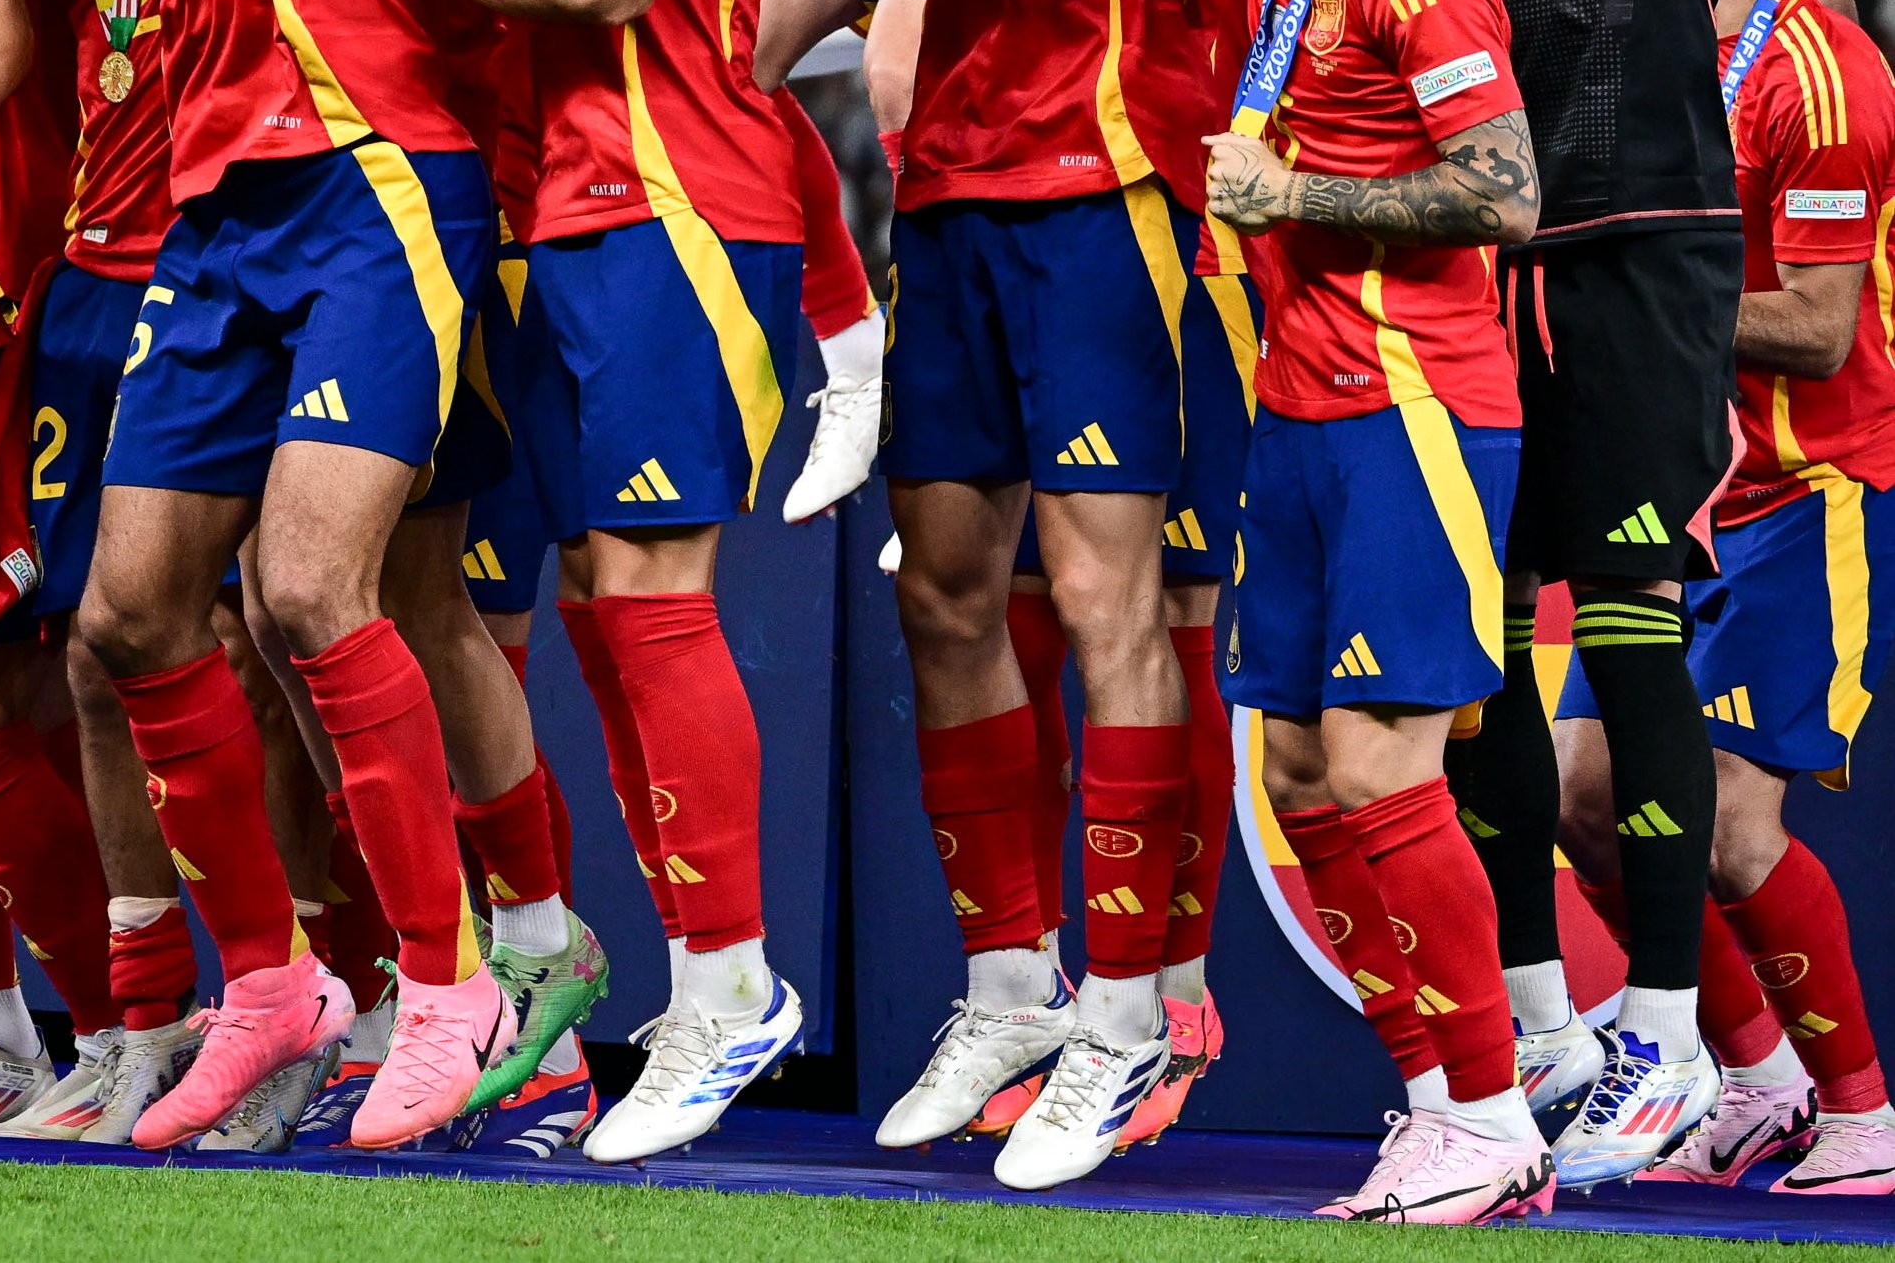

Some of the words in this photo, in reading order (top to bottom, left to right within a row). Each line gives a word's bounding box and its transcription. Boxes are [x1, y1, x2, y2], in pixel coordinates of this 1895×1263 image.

[1416, 61, 1493, 96] FOUNDATION
[1059, 155, 1098, 167] HEAT.RDY
[589, 184, 627, 196] HEAT.RDY
[1788, 199, 1864, 209] FOUNDATION
[1334, 373, 1370, 386] HEAT.RDY
[1012, 1014, 1037, 1023] COPA
